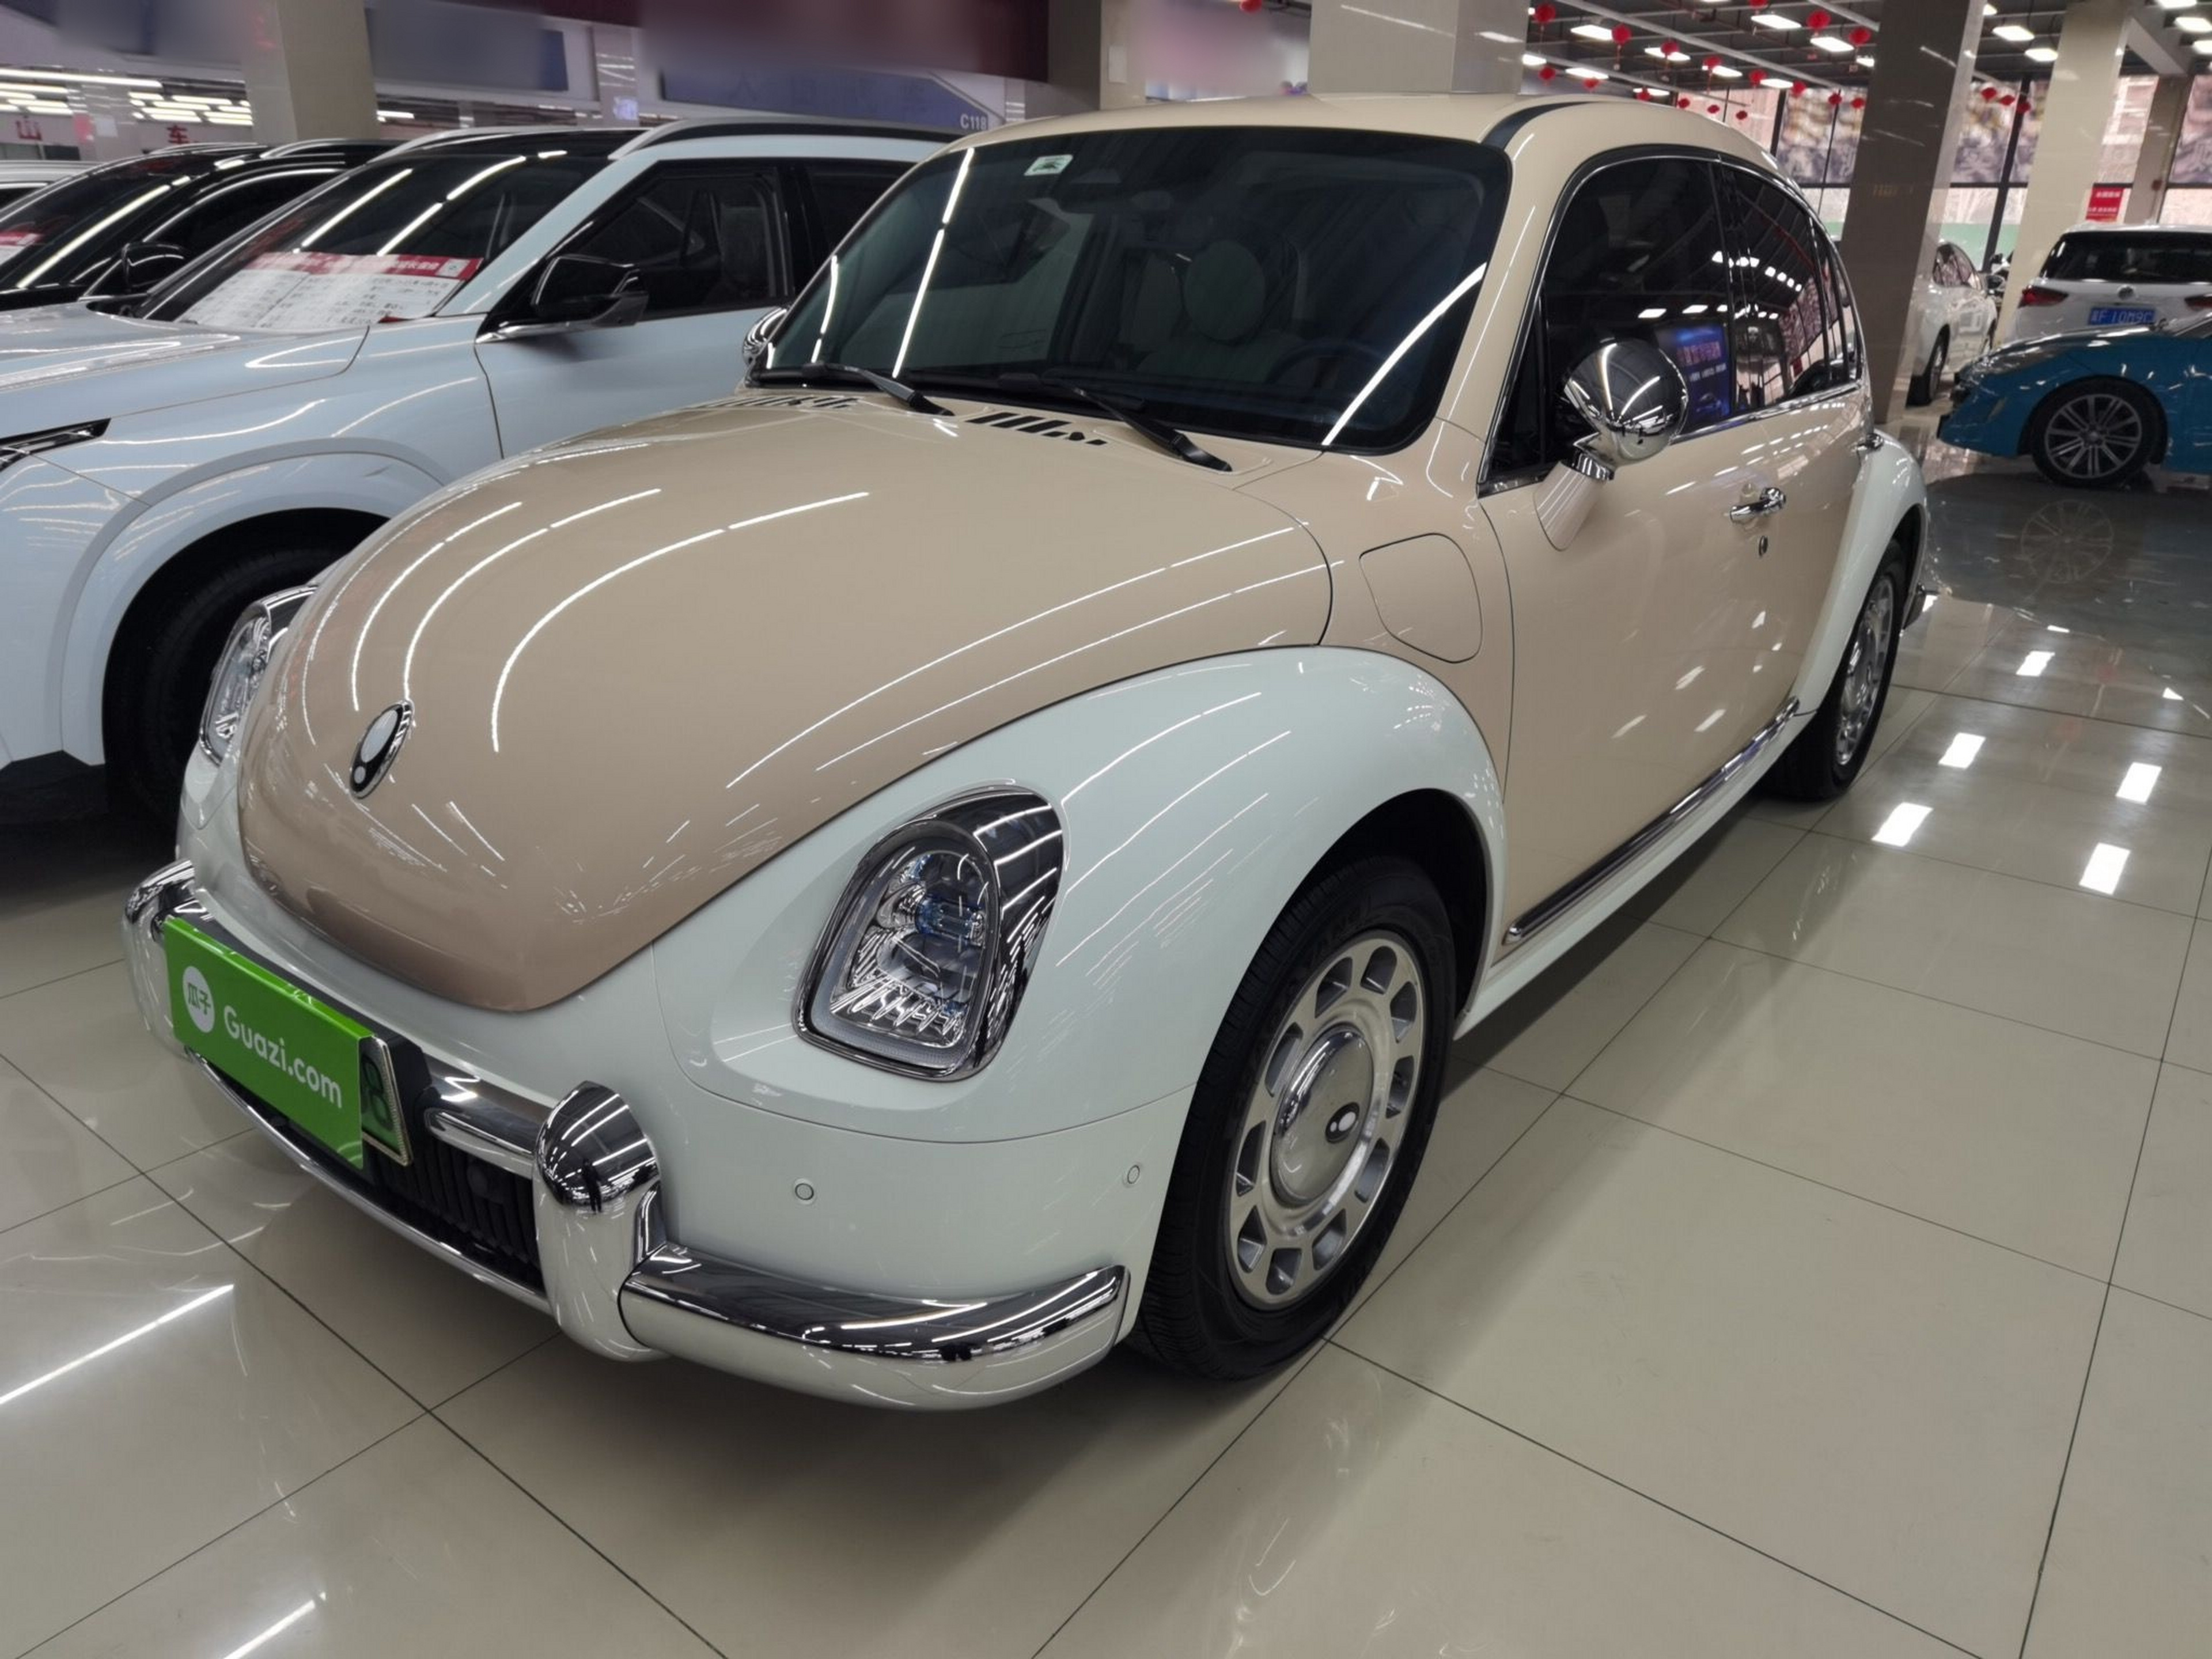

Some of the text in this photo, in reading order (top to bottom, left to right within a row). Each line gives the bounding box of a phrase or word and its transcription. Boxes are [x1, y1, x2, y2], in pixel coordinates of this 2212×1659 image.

[960, 113, 987, 131] C118
[187, 982, 212, 1016] 瓜子
[224, 1005, 343, 1109] Guazi.com
